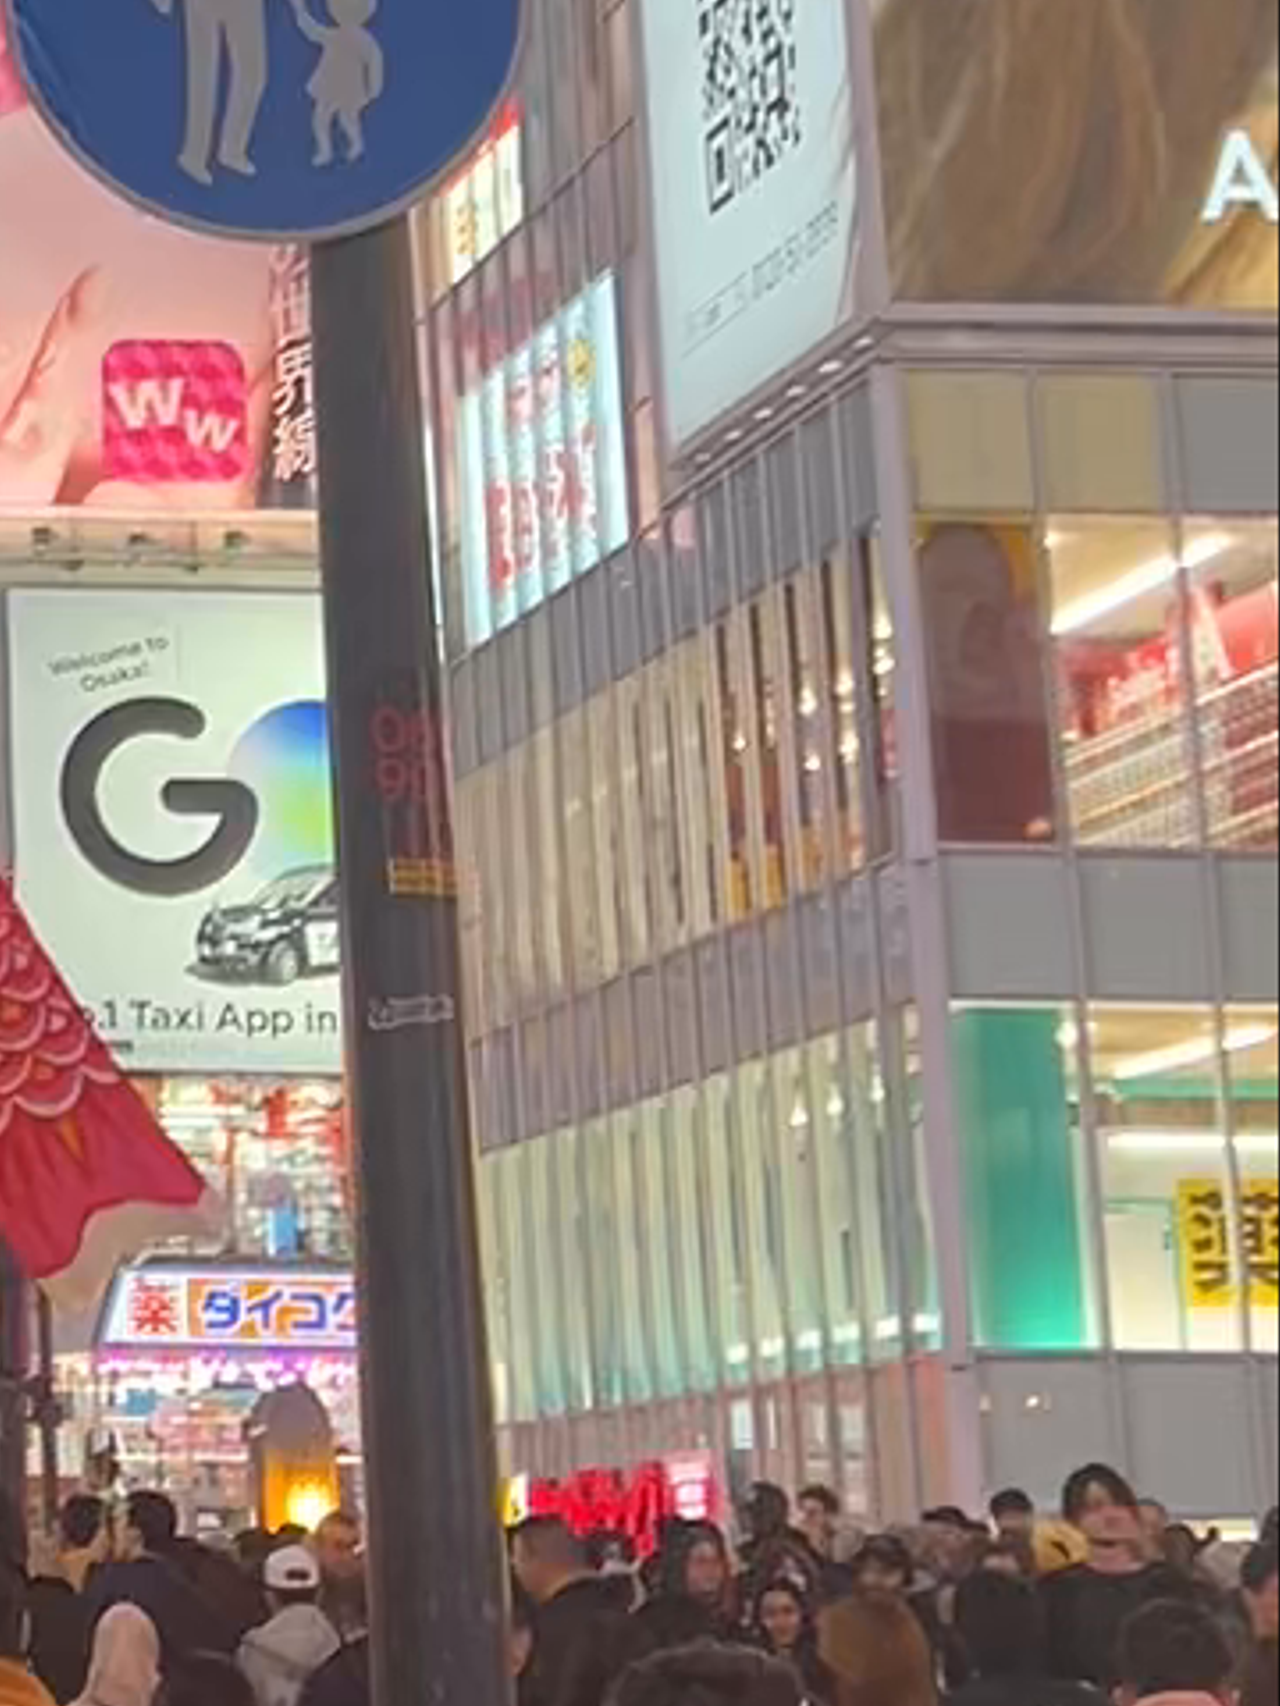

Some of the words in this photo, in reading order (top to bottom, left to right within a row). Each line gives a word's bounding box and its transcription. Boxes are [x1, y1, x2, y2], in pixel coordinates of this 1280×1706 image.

[46, 640, 142, 677] Welcome
[128, 998, 206, 1032] Taxi
[213, 1000, 297, 1040] App
[305, 1000, 339, 1032] in
